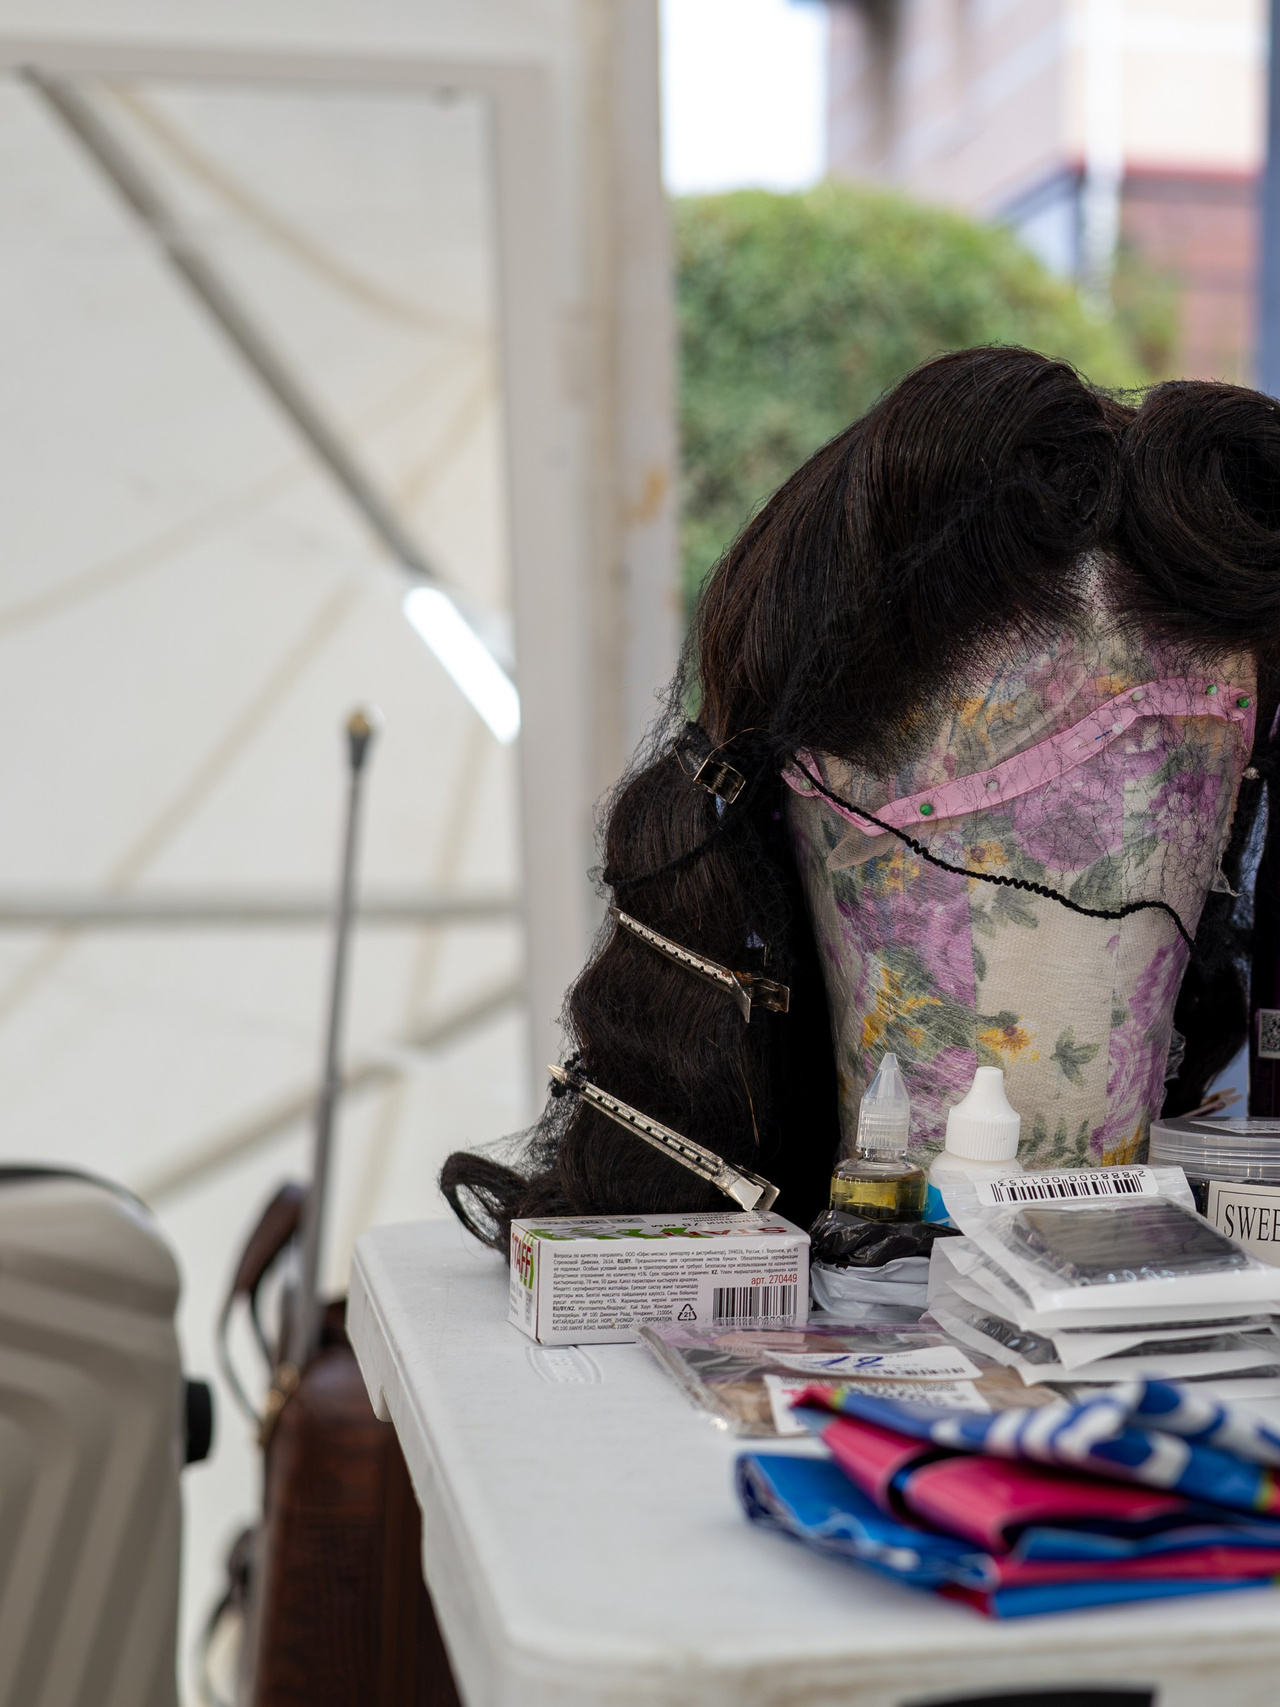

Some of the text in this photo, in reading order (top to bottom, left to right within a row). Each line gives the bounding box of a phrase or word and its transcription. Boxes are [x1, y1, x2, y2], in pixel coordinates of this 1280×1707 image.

[1137, 1170, 1146, 1178] 2
[751, 1274, 797, 1286] арт. 270449
